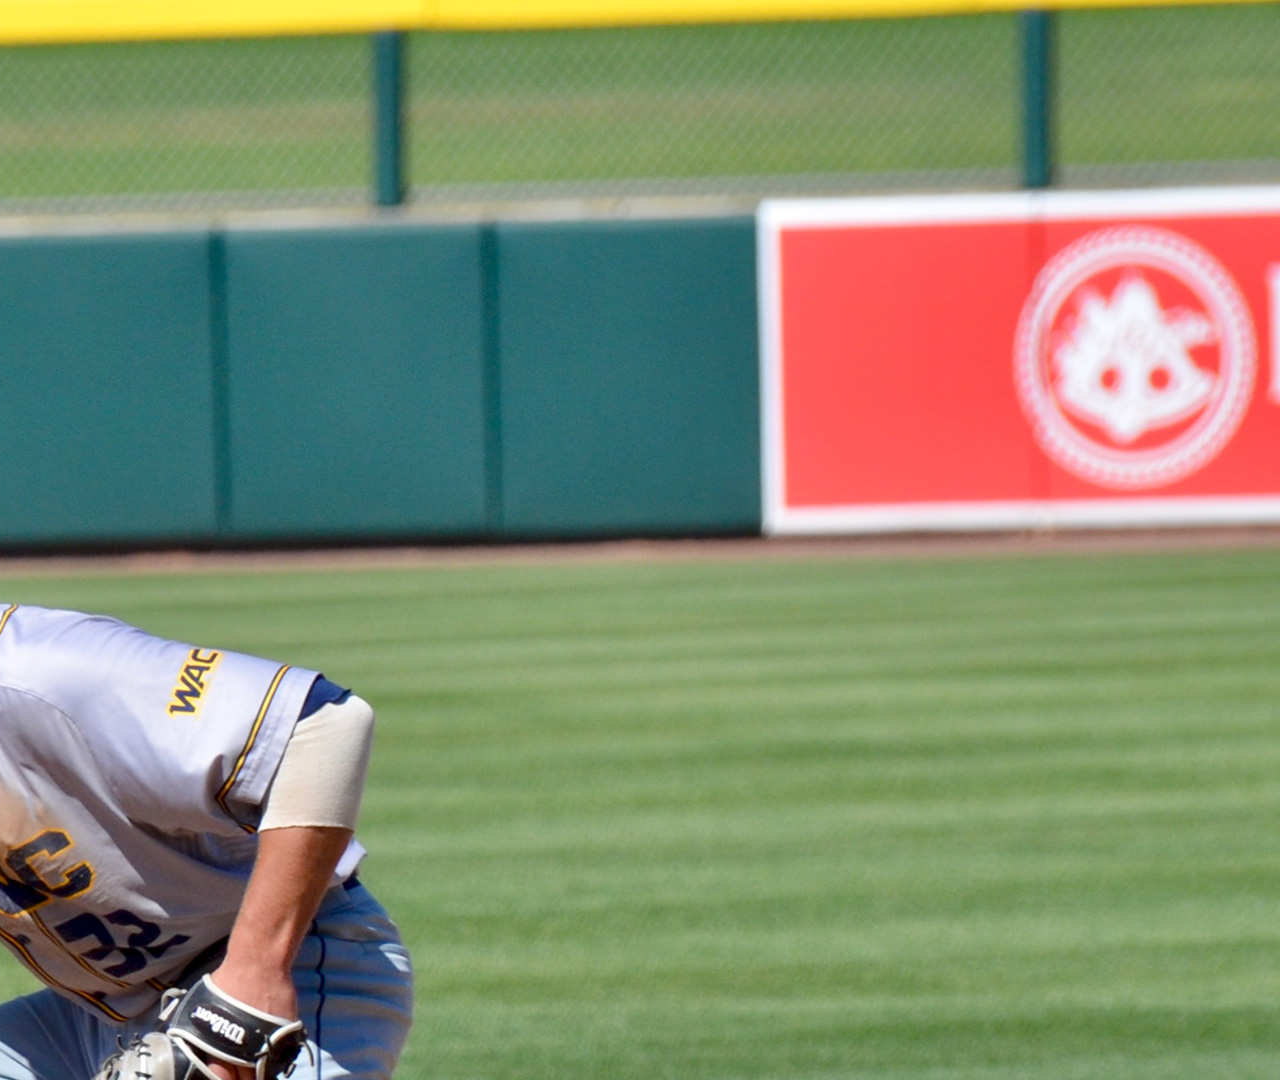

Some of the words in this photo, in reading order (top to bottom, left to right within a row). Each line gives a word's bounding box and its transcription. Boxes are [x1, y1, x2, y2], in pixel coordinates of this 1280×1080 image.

[166, 647, 224, 718] WAC
[54, 909, 191, 978] 32
[194, 1006, 246, 1045] Wilson
